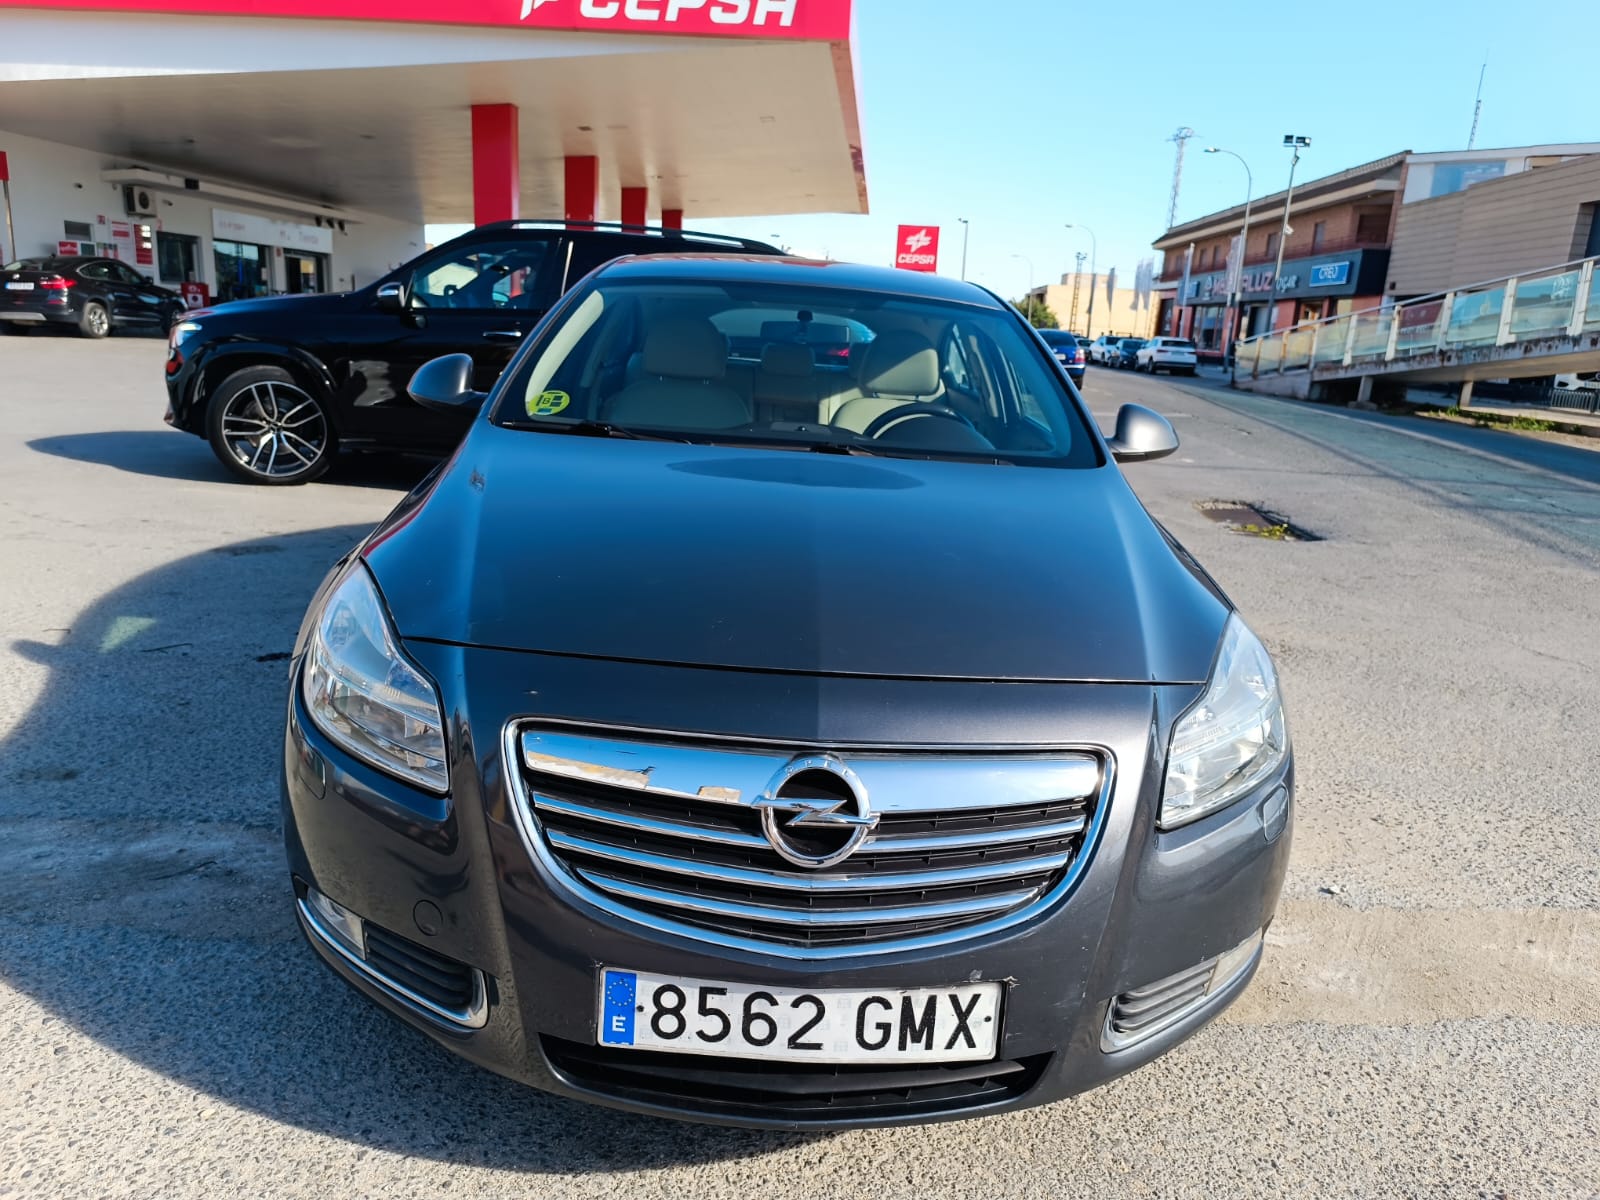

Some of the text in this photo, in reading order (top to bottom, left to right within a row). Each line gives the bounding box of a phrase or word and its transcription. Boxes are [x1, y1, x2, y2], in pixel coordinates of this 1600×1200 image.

[897, 254, 936, 265] CEPSA
[785, 759, 850, 778] OPEL
[611, 1015, 627, 1033] E
[651, 983, 982, 1051] 8562 GMX
